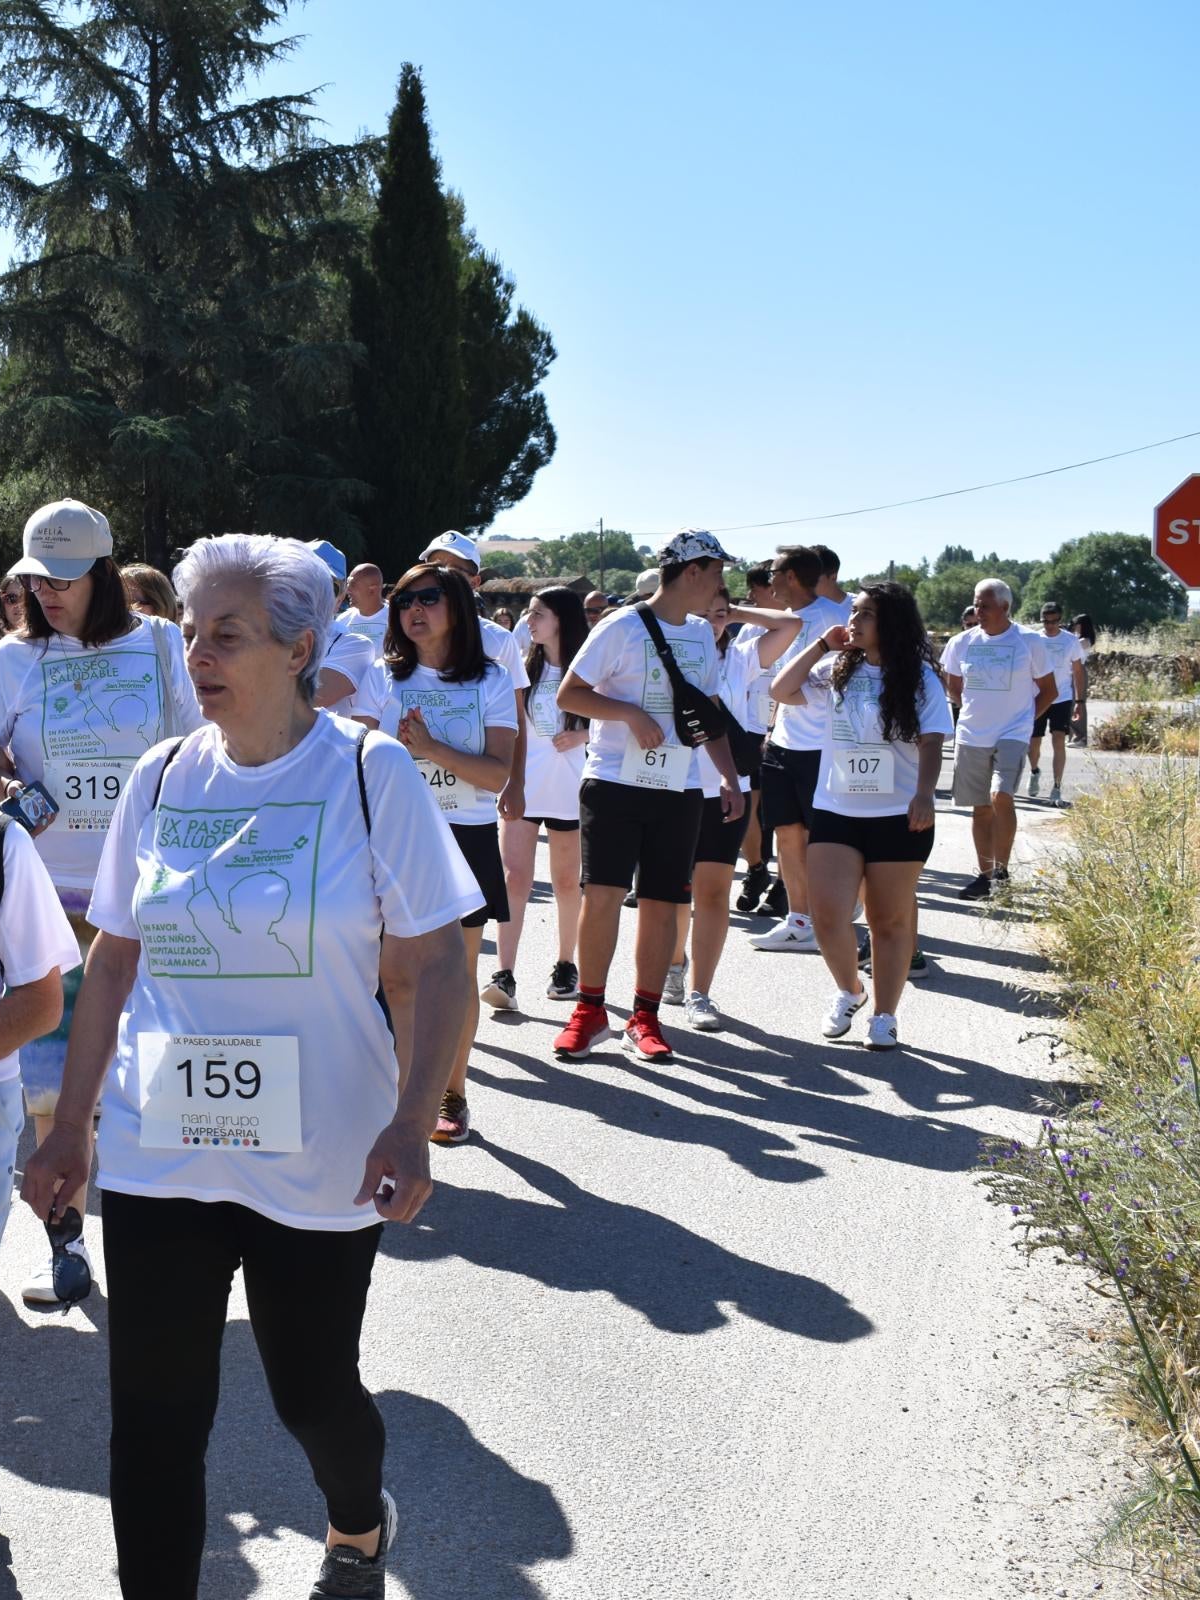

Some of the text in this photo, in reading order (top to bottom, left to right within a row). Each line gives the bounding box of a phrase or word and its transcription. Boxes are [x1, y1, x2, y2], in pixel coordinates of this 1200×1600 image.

[49, 659, 110, 676] IX PASEO
[50, 667, 120, 686] SALUDABLE
[58, 735, 70, 743] LOS
[70, 733, 91, 741] NIÑOS
[645, 750, 667, 768] 61
[847, 758, 881, 774] 107
[64, 775, 121, 800] 319
[68, 808, 88, 817] nani
[161, 817, 182, 834] IX
[158, 829, 260, 849] SALUDALE
[232, 853, 295, 864] San Jerónimo
[151, 923, 178, 931] FAVOR
[153, 935, 167, 943] LOS
[168, 932, 197, 943] NIÑOS
[173, 1037, 262, 1047] IX PASEO SALUDABLE
[176, 1058, 262, 1100] 159
[181, 1111, 260, 1128] nani grupo
[181, 1126, 261, 1139] EMPRESARIAL
